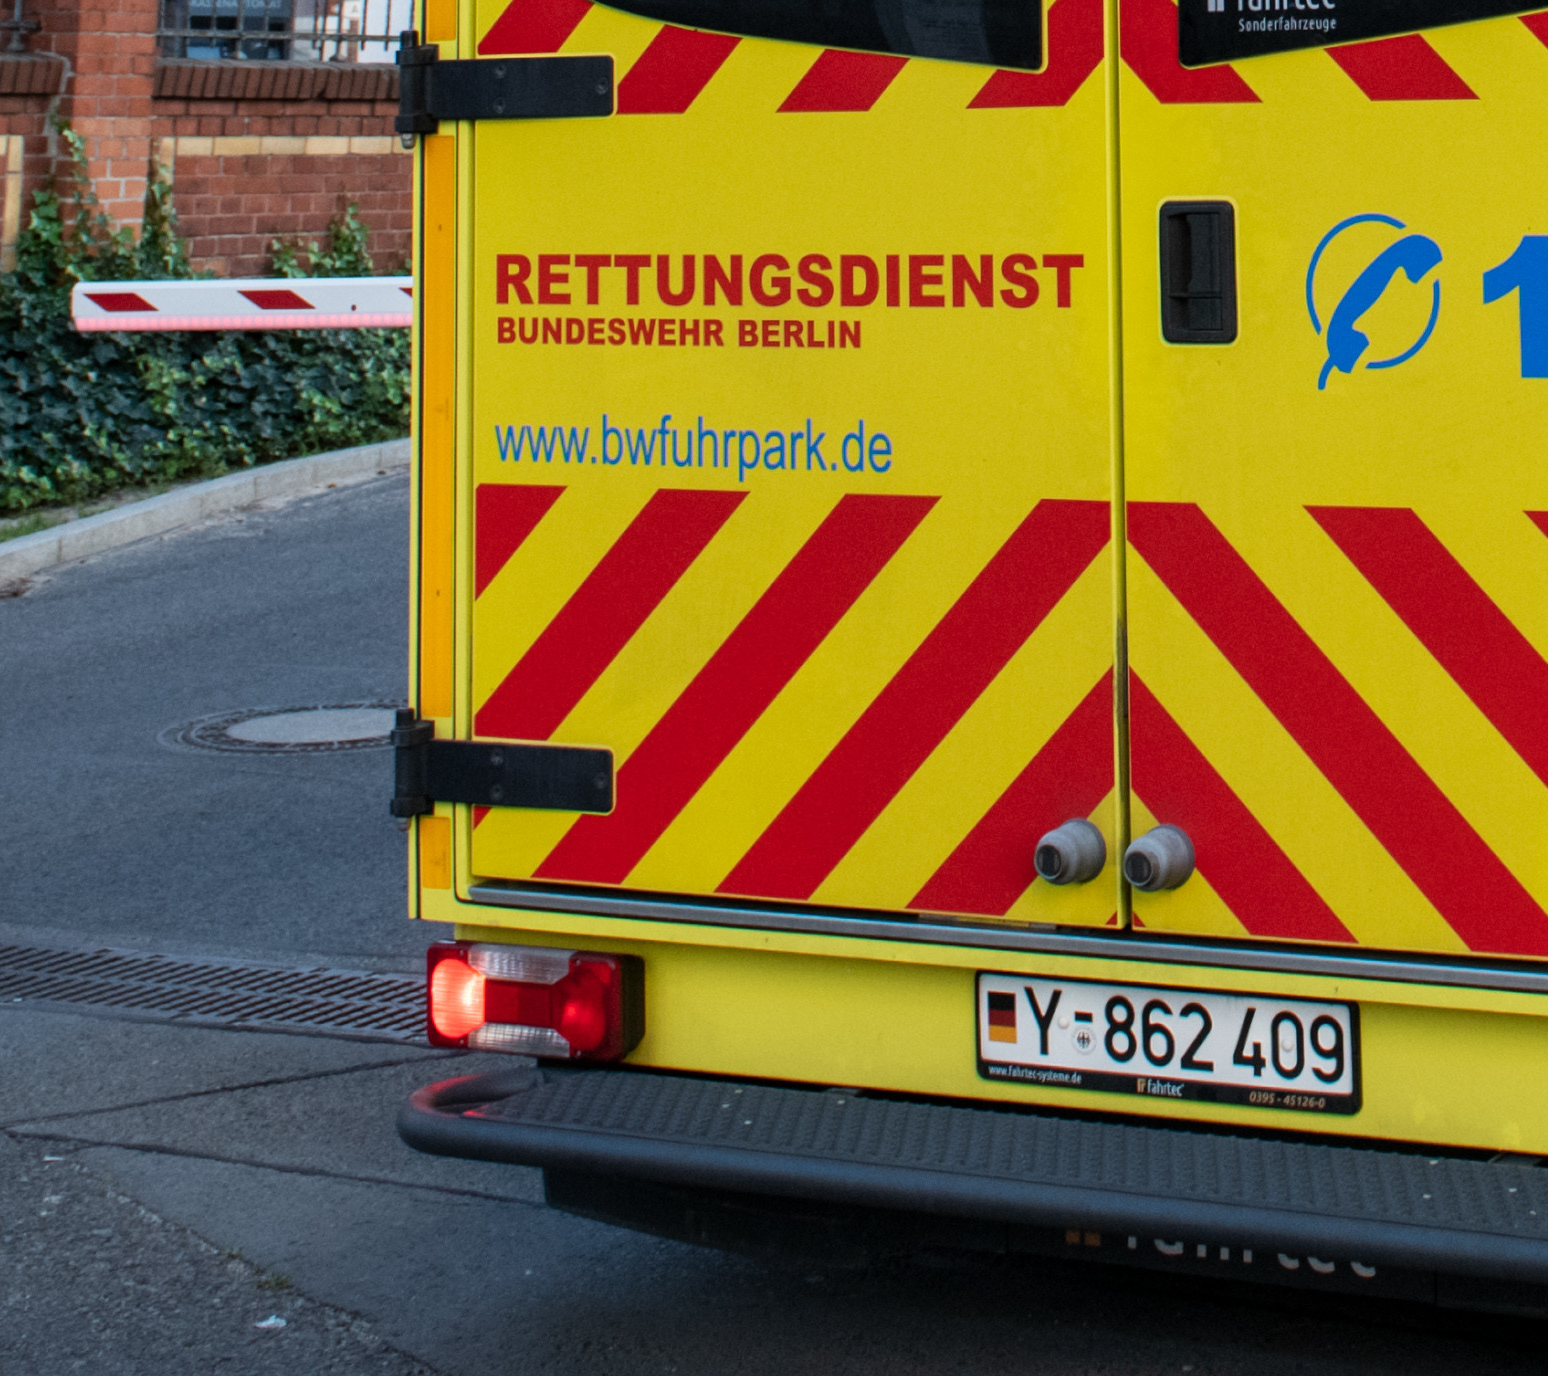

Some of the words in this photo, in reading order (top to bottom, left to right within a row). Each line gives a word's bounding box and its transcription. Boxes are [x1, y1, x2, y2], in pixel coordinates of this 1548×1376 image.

[1238, 16, 1337, 33] Sonderfahrzeuge
[495, 252, 1085, 309] RETTUNGSDIENST
[496, 316, 724, 347] BUNDESWEHR
[738, 319, 862, 349] BERLIN
[494, 413, 893, 483] www.bwfuhrpark.de
[1232, 1007, 1345, 1084] 409
[1249, 1090, 1275, 1105] 0395
